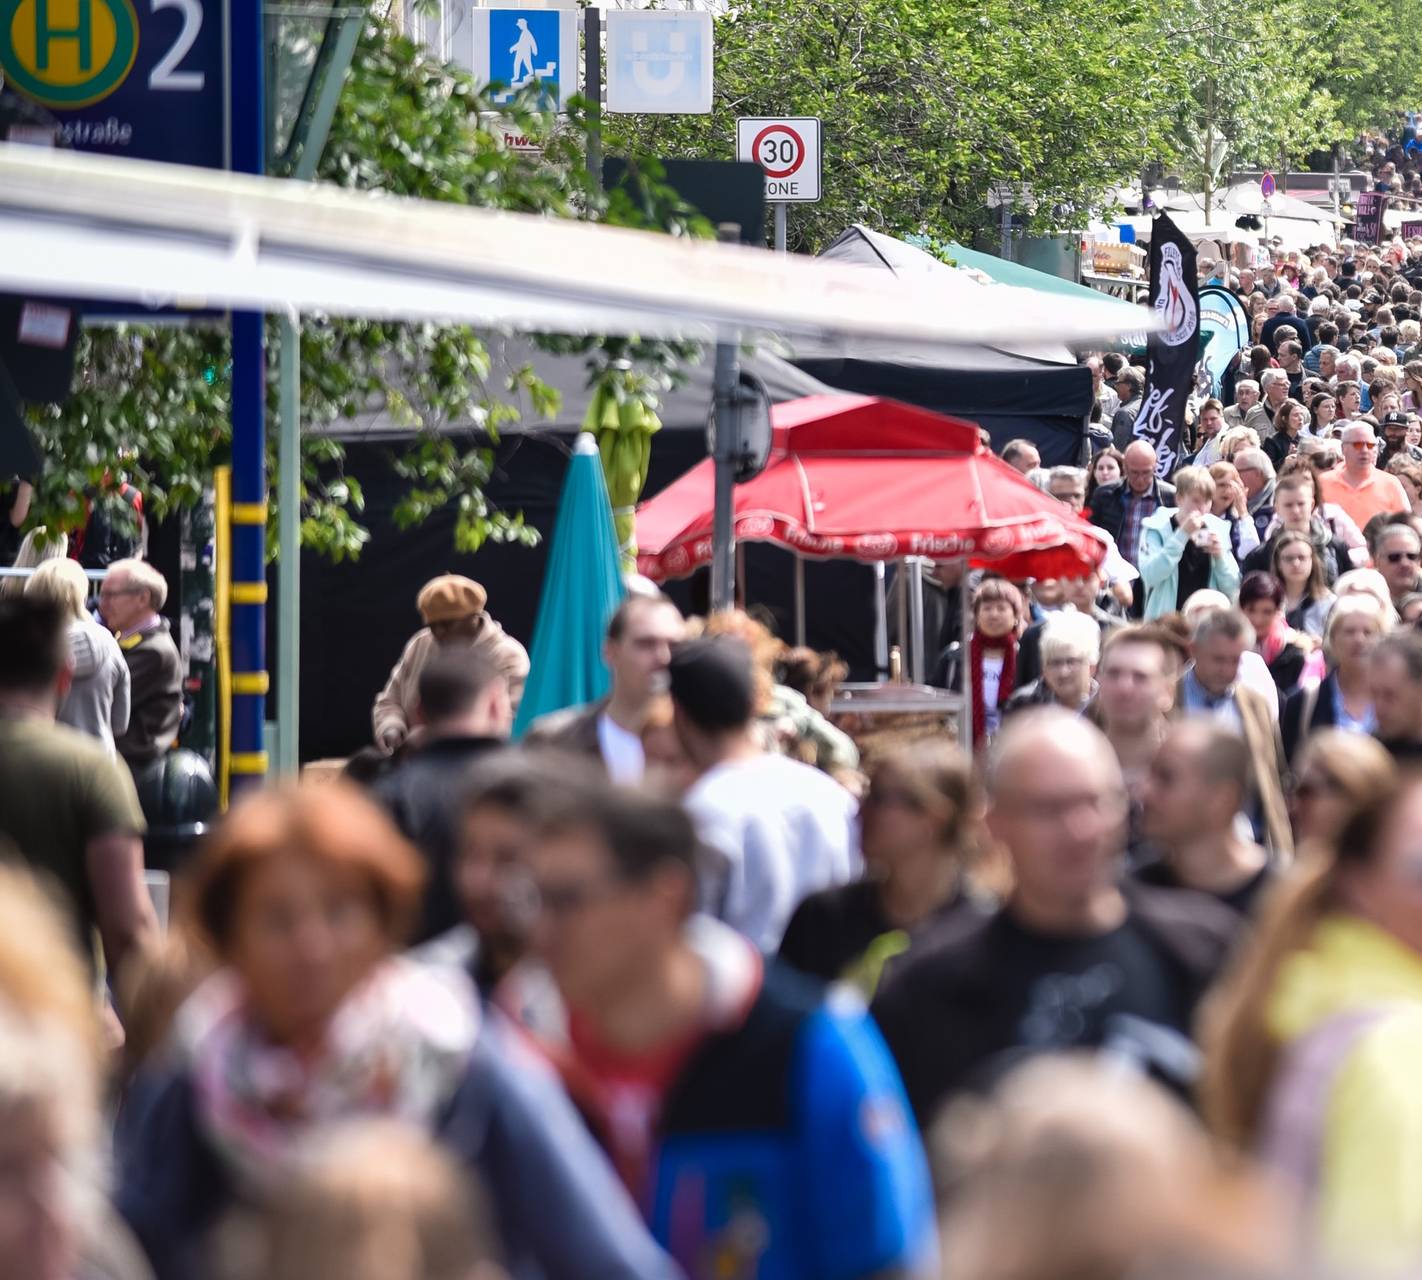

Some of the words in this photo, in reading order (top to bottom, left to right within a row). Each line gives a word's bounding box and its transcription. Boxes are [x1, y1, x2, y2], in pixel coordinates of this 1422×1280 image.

[36, 0, 93, 71] H
[149, 0, 206, 90] 2
[56, 116, 133, 145] straße
[764, 139, 794, 163] 30
